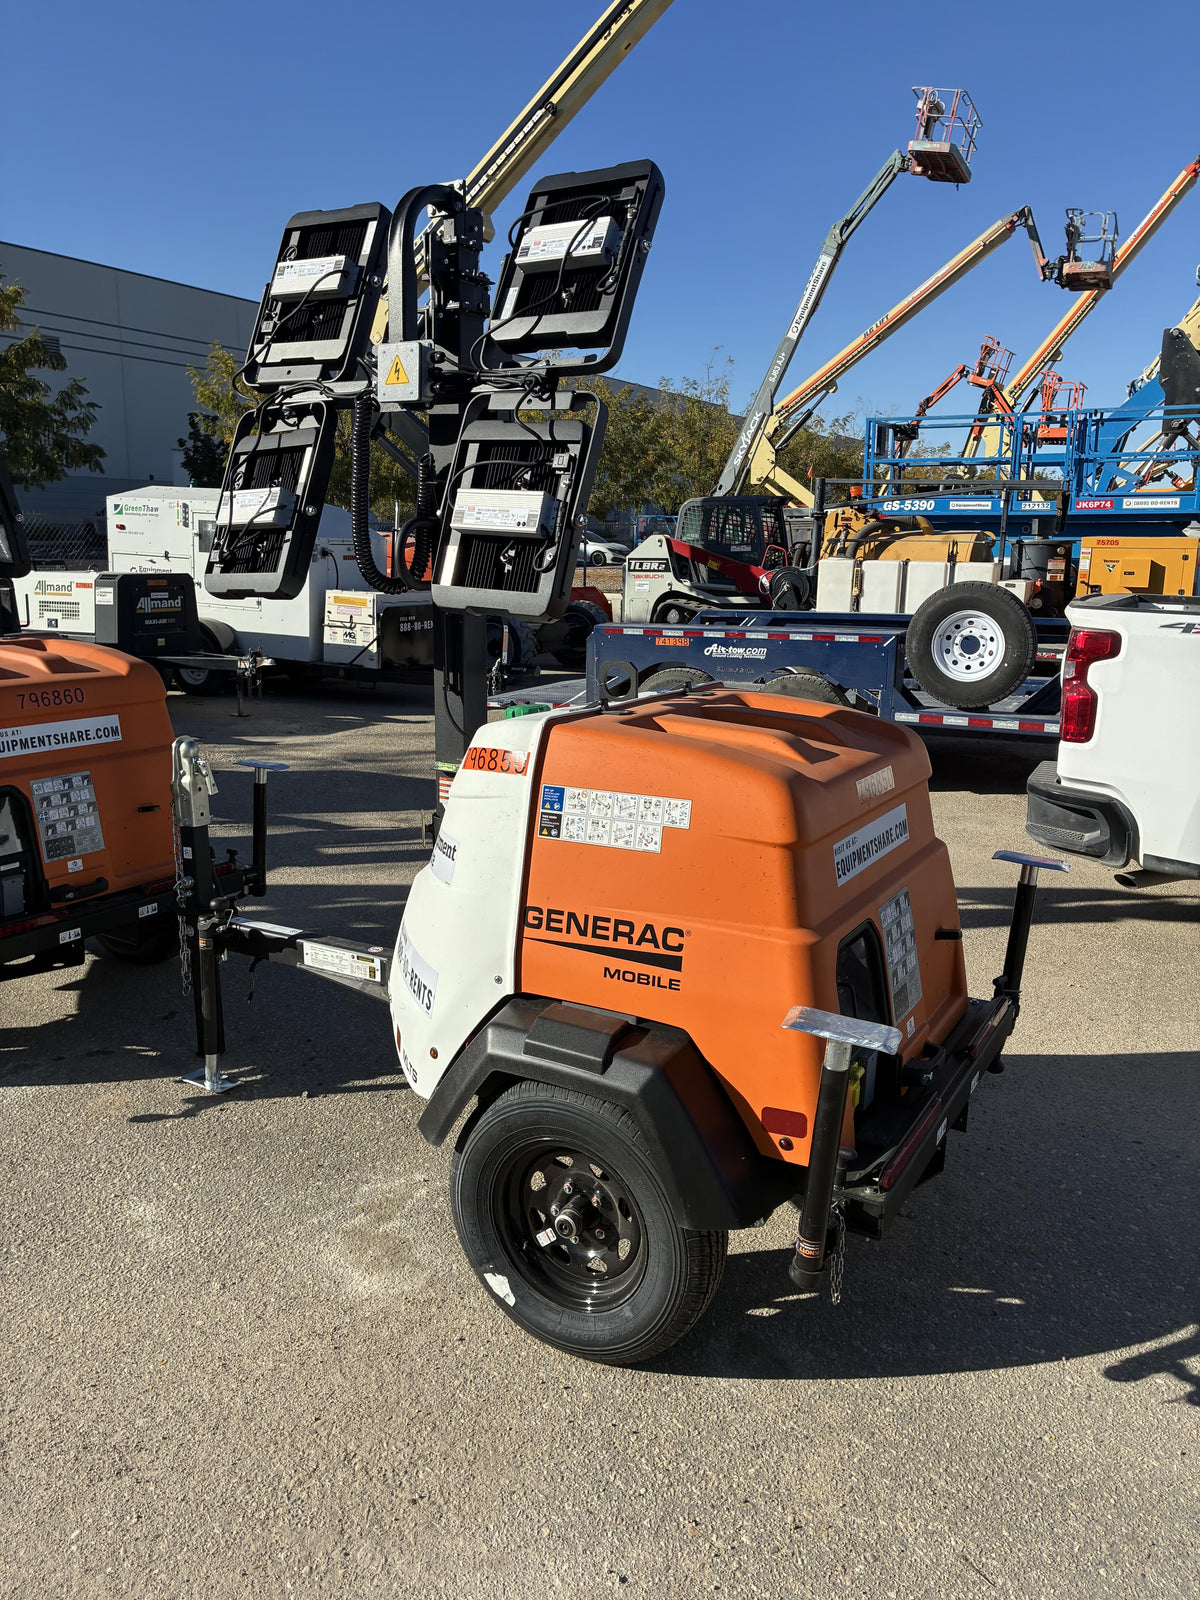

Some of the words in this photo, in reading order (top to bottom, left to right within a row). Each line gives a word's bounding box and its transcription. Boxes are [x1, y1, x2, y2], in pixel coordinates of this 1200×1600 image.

[795, 261, 827, 326] EquipmentShare
[863, 326, 874, 340] JLG
[875, 313, 889, 328] LIFT
[733, 411, 762, 466] SKYJACK
[124, 504, 159, 512] GreenThaw
[883, 500, 935, 511] GS-5390
[1076, 501, 1111, 509] JK6P74
[34, 580, 73, 595] Allmand
[136, 596, 182, 613] Allmand
[656, 638, 689, 646] 741398
[703, 643, 767, 656] Air-tow.com
[16, 687, 85, 709] 796860
[834, 845, 845, 857] VISIT
[835, 819, 908, 879] EQUIPMENTSHARE.COM
[523, 905, 685, 953] GENERAC
[603, 966, 681, 991] MOBILE
